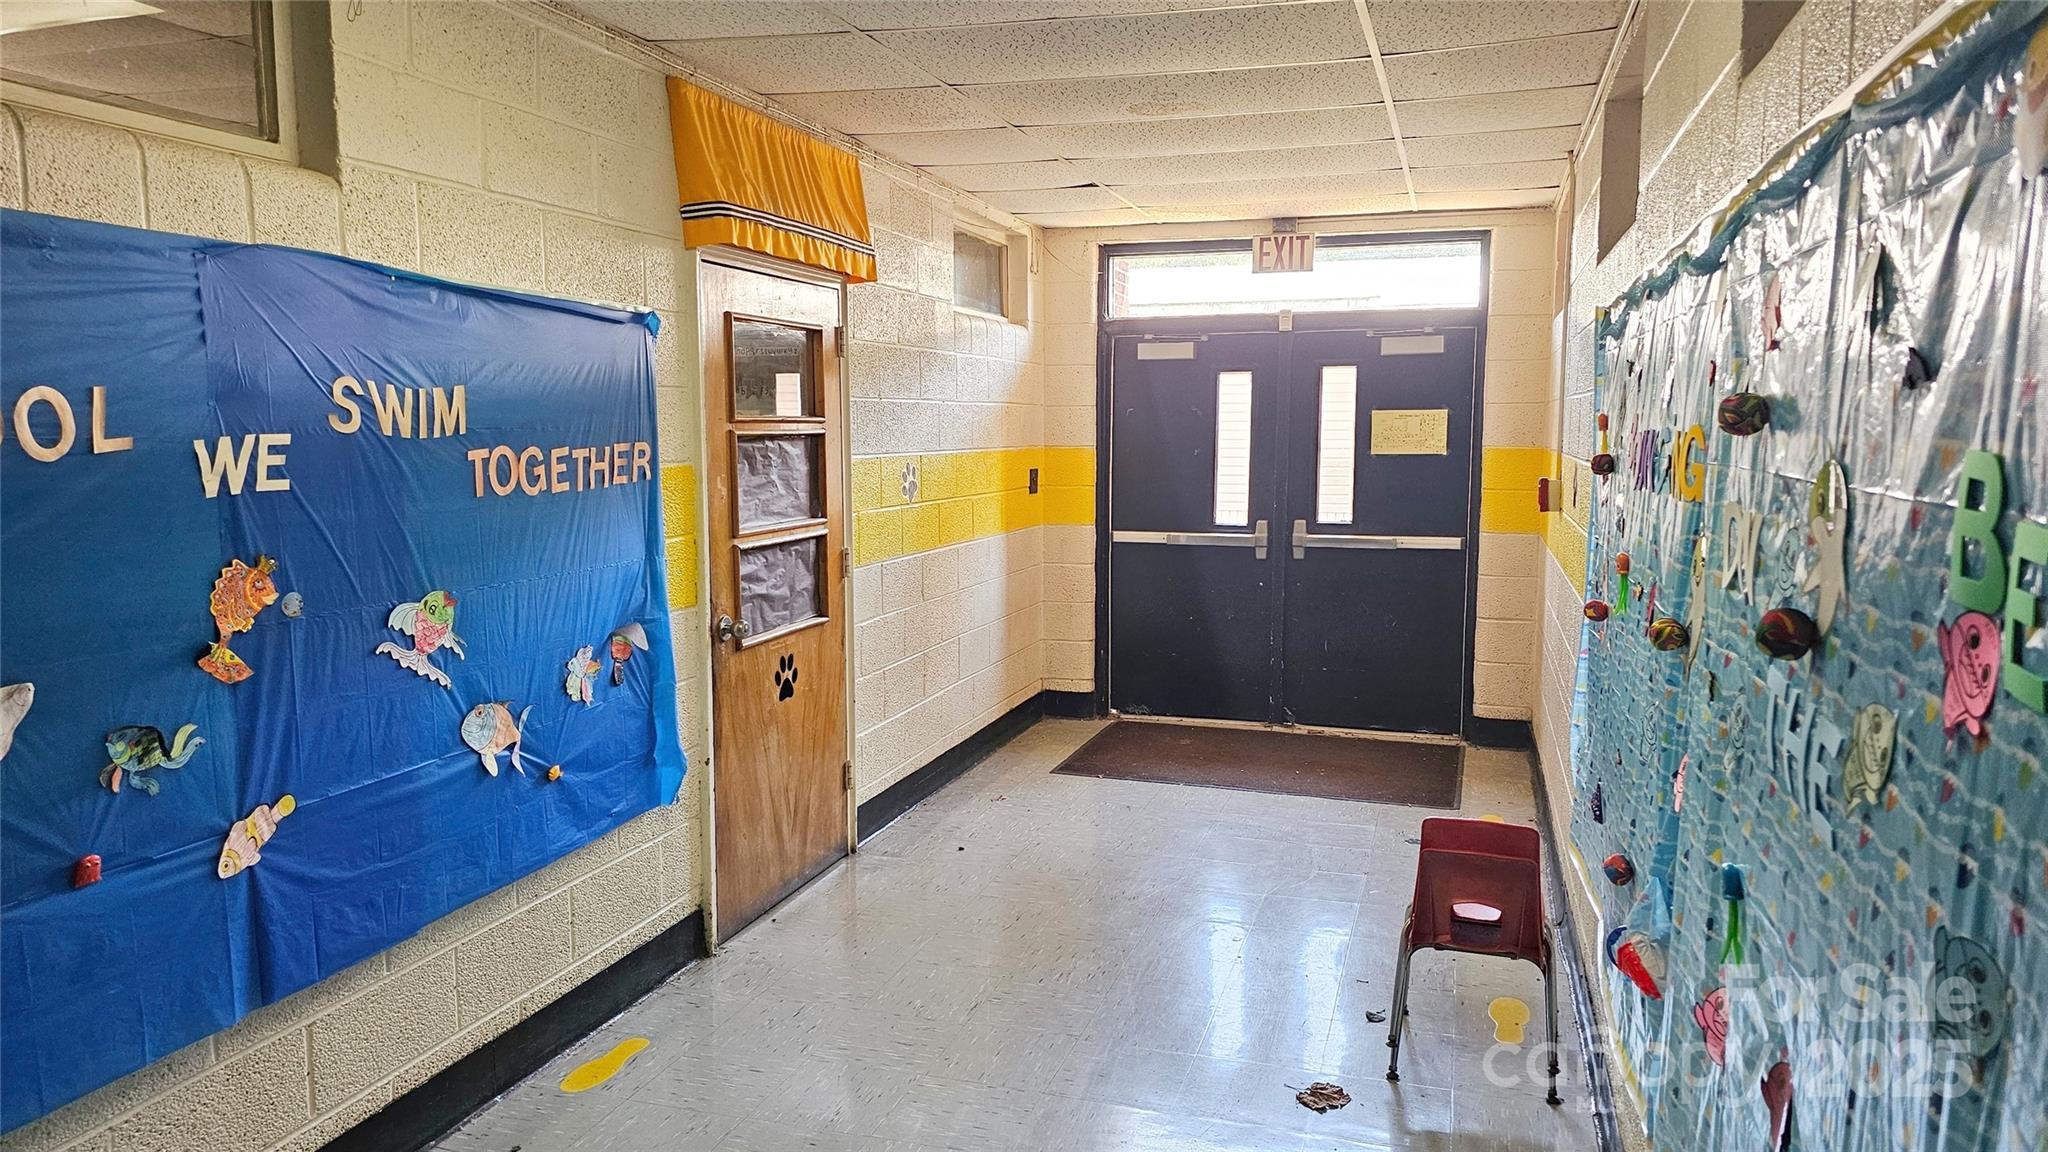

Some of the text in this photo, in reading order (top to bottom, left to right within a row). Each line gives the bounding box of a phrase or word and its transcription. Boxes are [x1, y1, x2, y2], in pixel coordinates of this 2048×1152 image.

[1258, 235, 1310, 271] EXIT
[0, 376, 652, 498] OL WE SWIM TOGETHER
[1767, 665, 1843, 850] THE
[1950, 450, 2048, 713] BE
